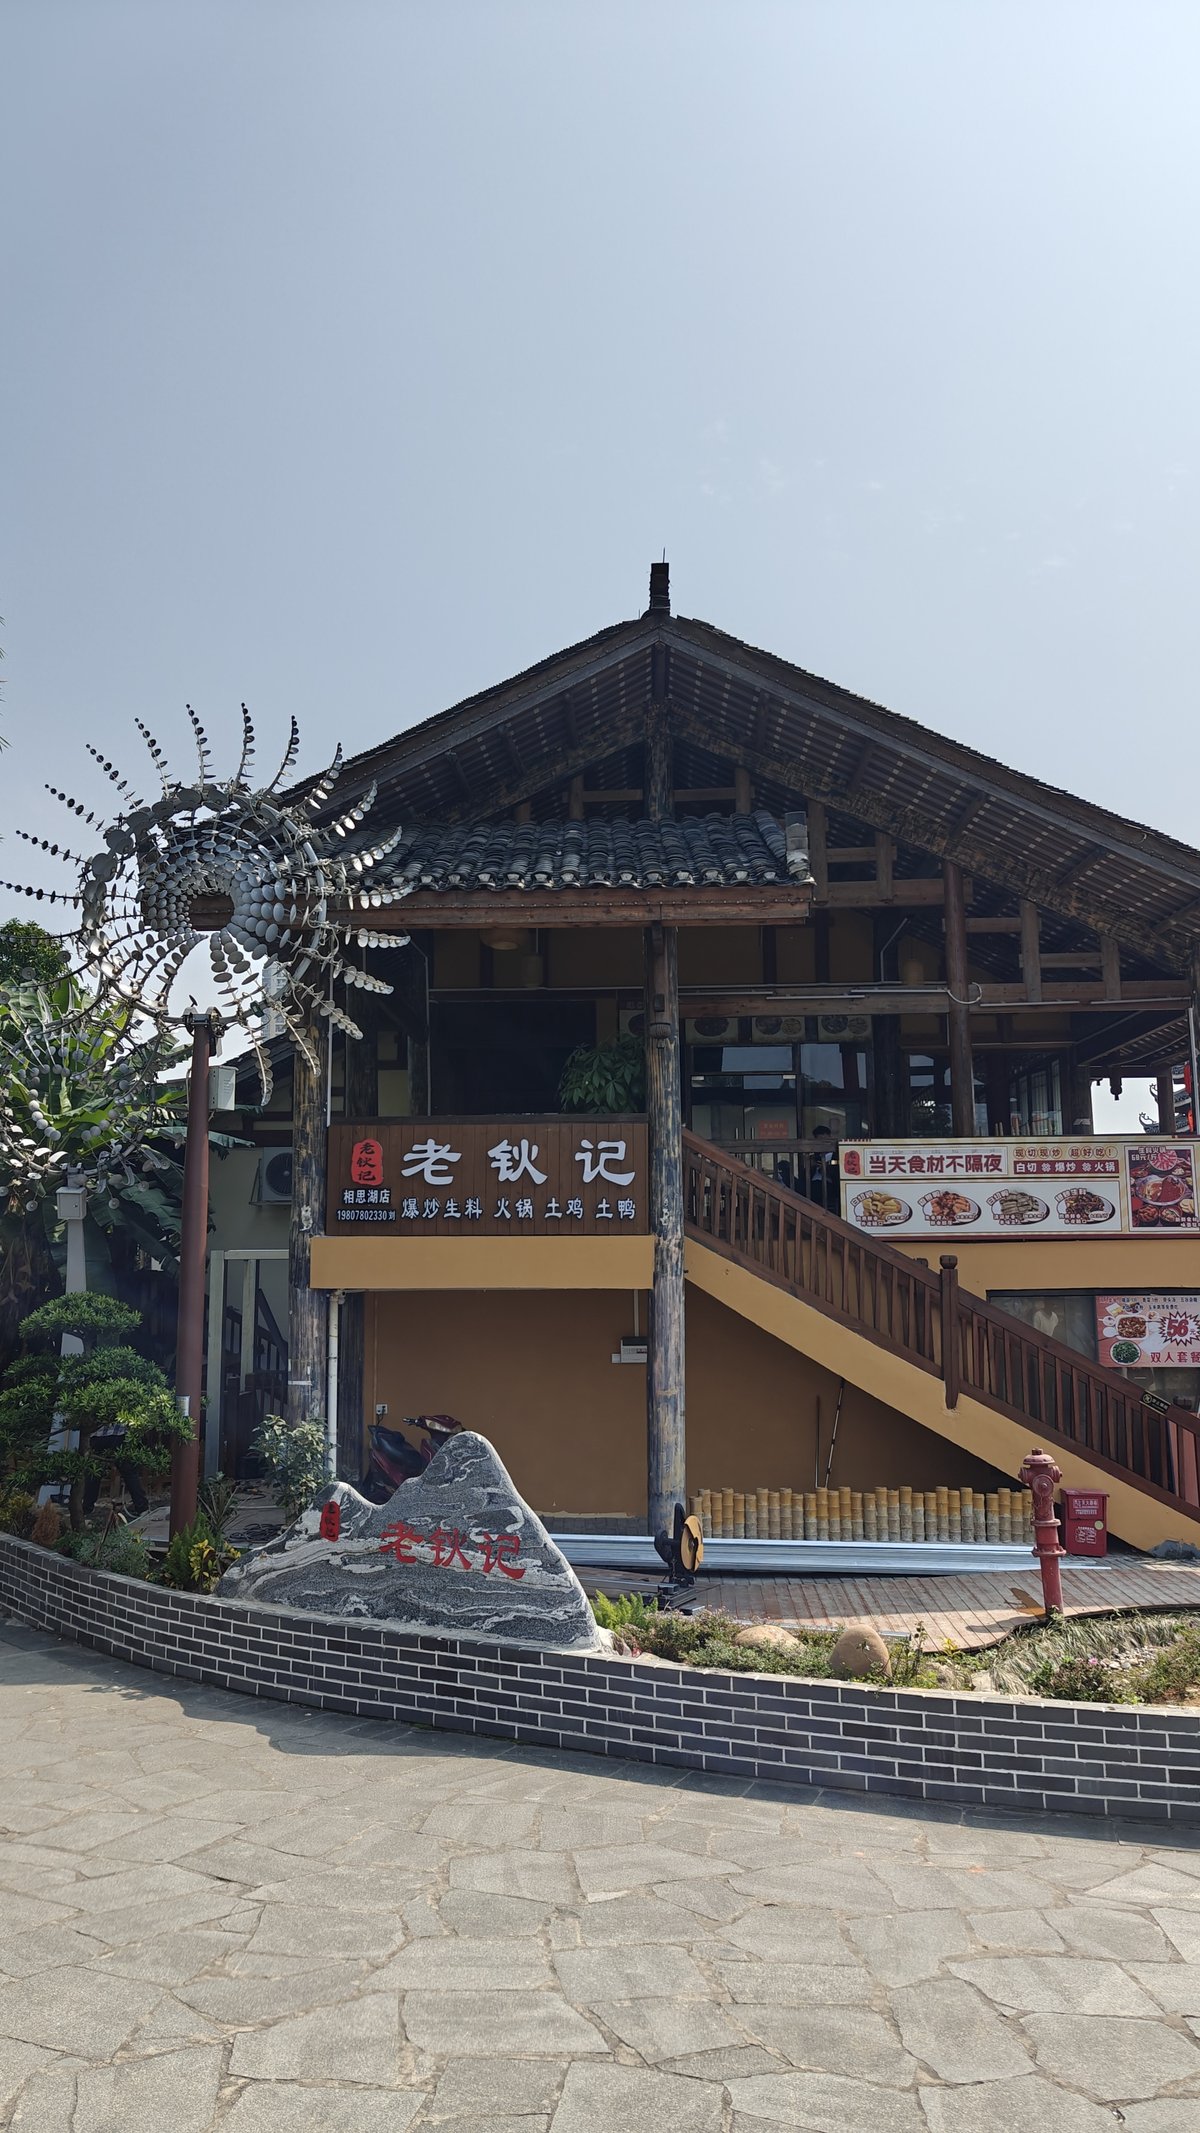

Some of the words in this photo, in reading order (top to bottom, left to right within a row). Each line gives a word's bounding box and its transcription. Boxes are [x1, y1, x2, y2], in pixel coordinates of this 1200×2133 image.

[355, 1141, 376, 1183] 老钬记
[401, 1138, 636, 1187] 老钬记
[1014, 1146, 1062, 1159] 现切现炒
[868, 1154, 1003, 1174] 当天食材不隔夜
[1016, 1162, 1037, 1173] 白切
[1055, 1161, 1076, 1172] 爆炒
[1094, 1161, 1115, 1172] 火锅
[343, 1189, 391, 1205] 相思湖店
[400, 1197, 483, 1220] 爆炒生料
[493, 1197, 534, 1220] 火锅
[544, 1197, 584, 1219] 土鸡
[595, 1197, 636, 1220] 土鸭
[1150, 1351, 1200, 1364] 双人套餐
[379, 1520, 526, 1580] 老钬记
